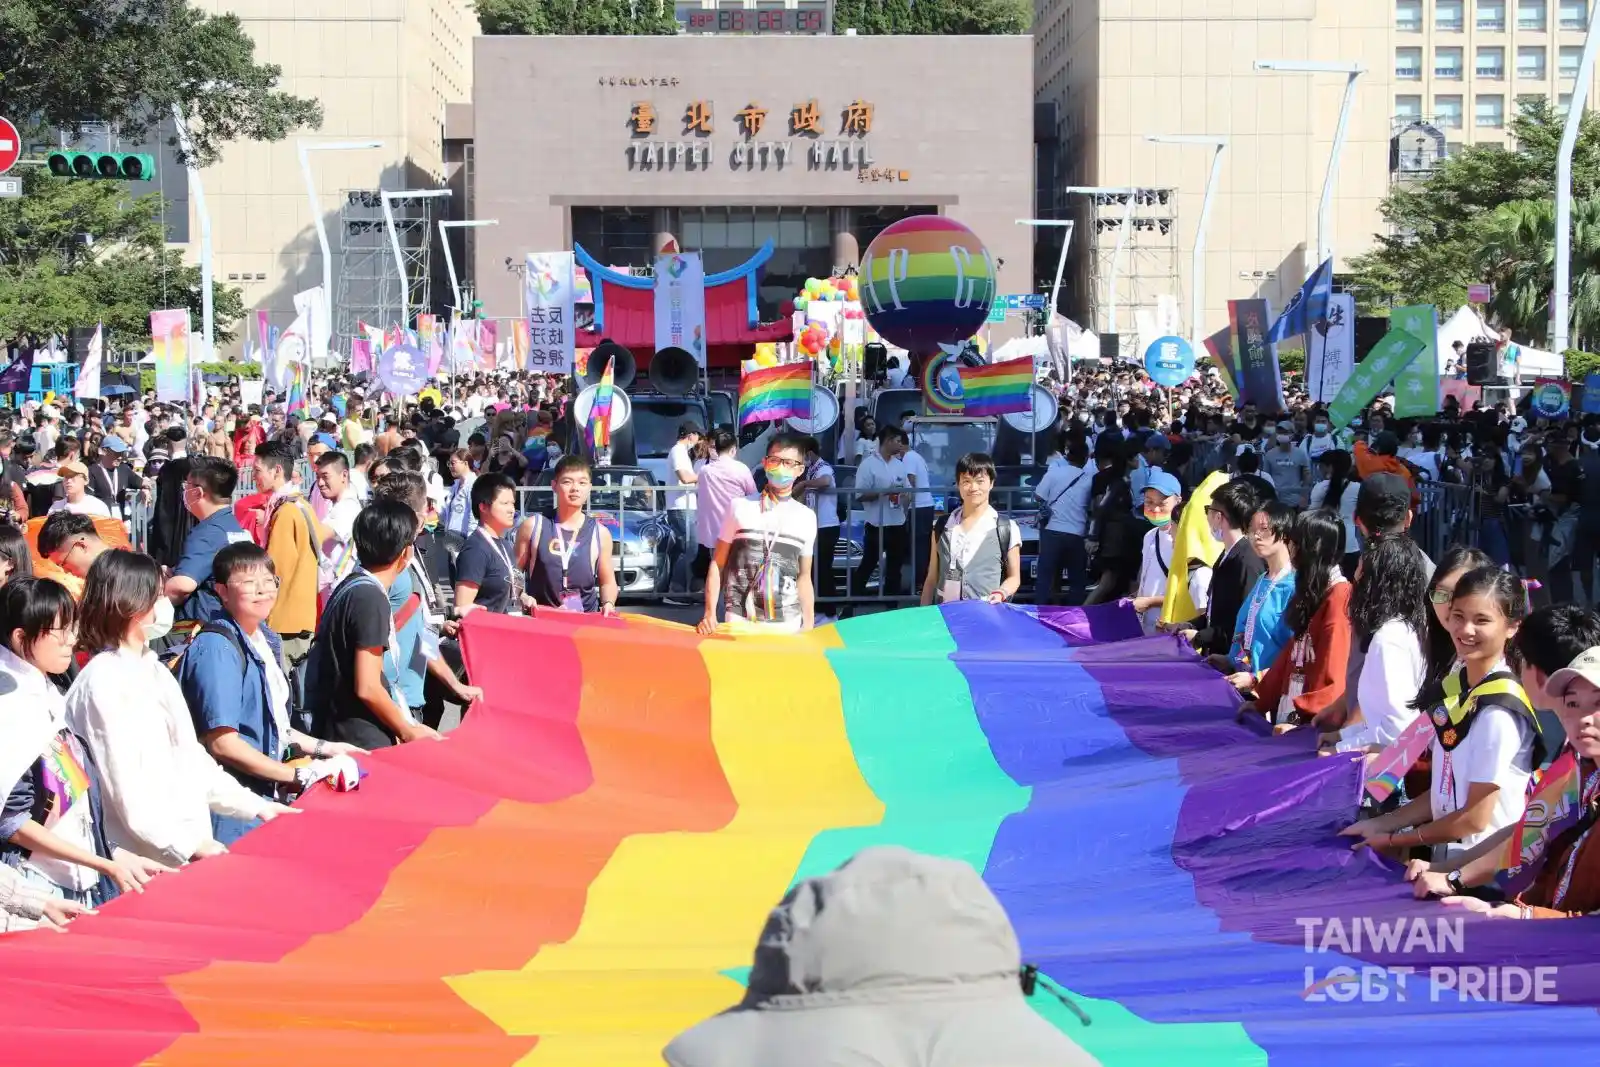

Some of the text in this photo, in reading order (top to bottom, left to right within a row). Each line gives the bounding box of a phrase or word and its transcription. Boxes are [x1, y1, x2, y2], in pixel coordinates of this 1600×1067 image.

[630, 99, 875, 136] 臺北市政府
[631, 139, 875, 165] TAIPEI CITY HALL
[1159, 342, 1180, 360] 藍
